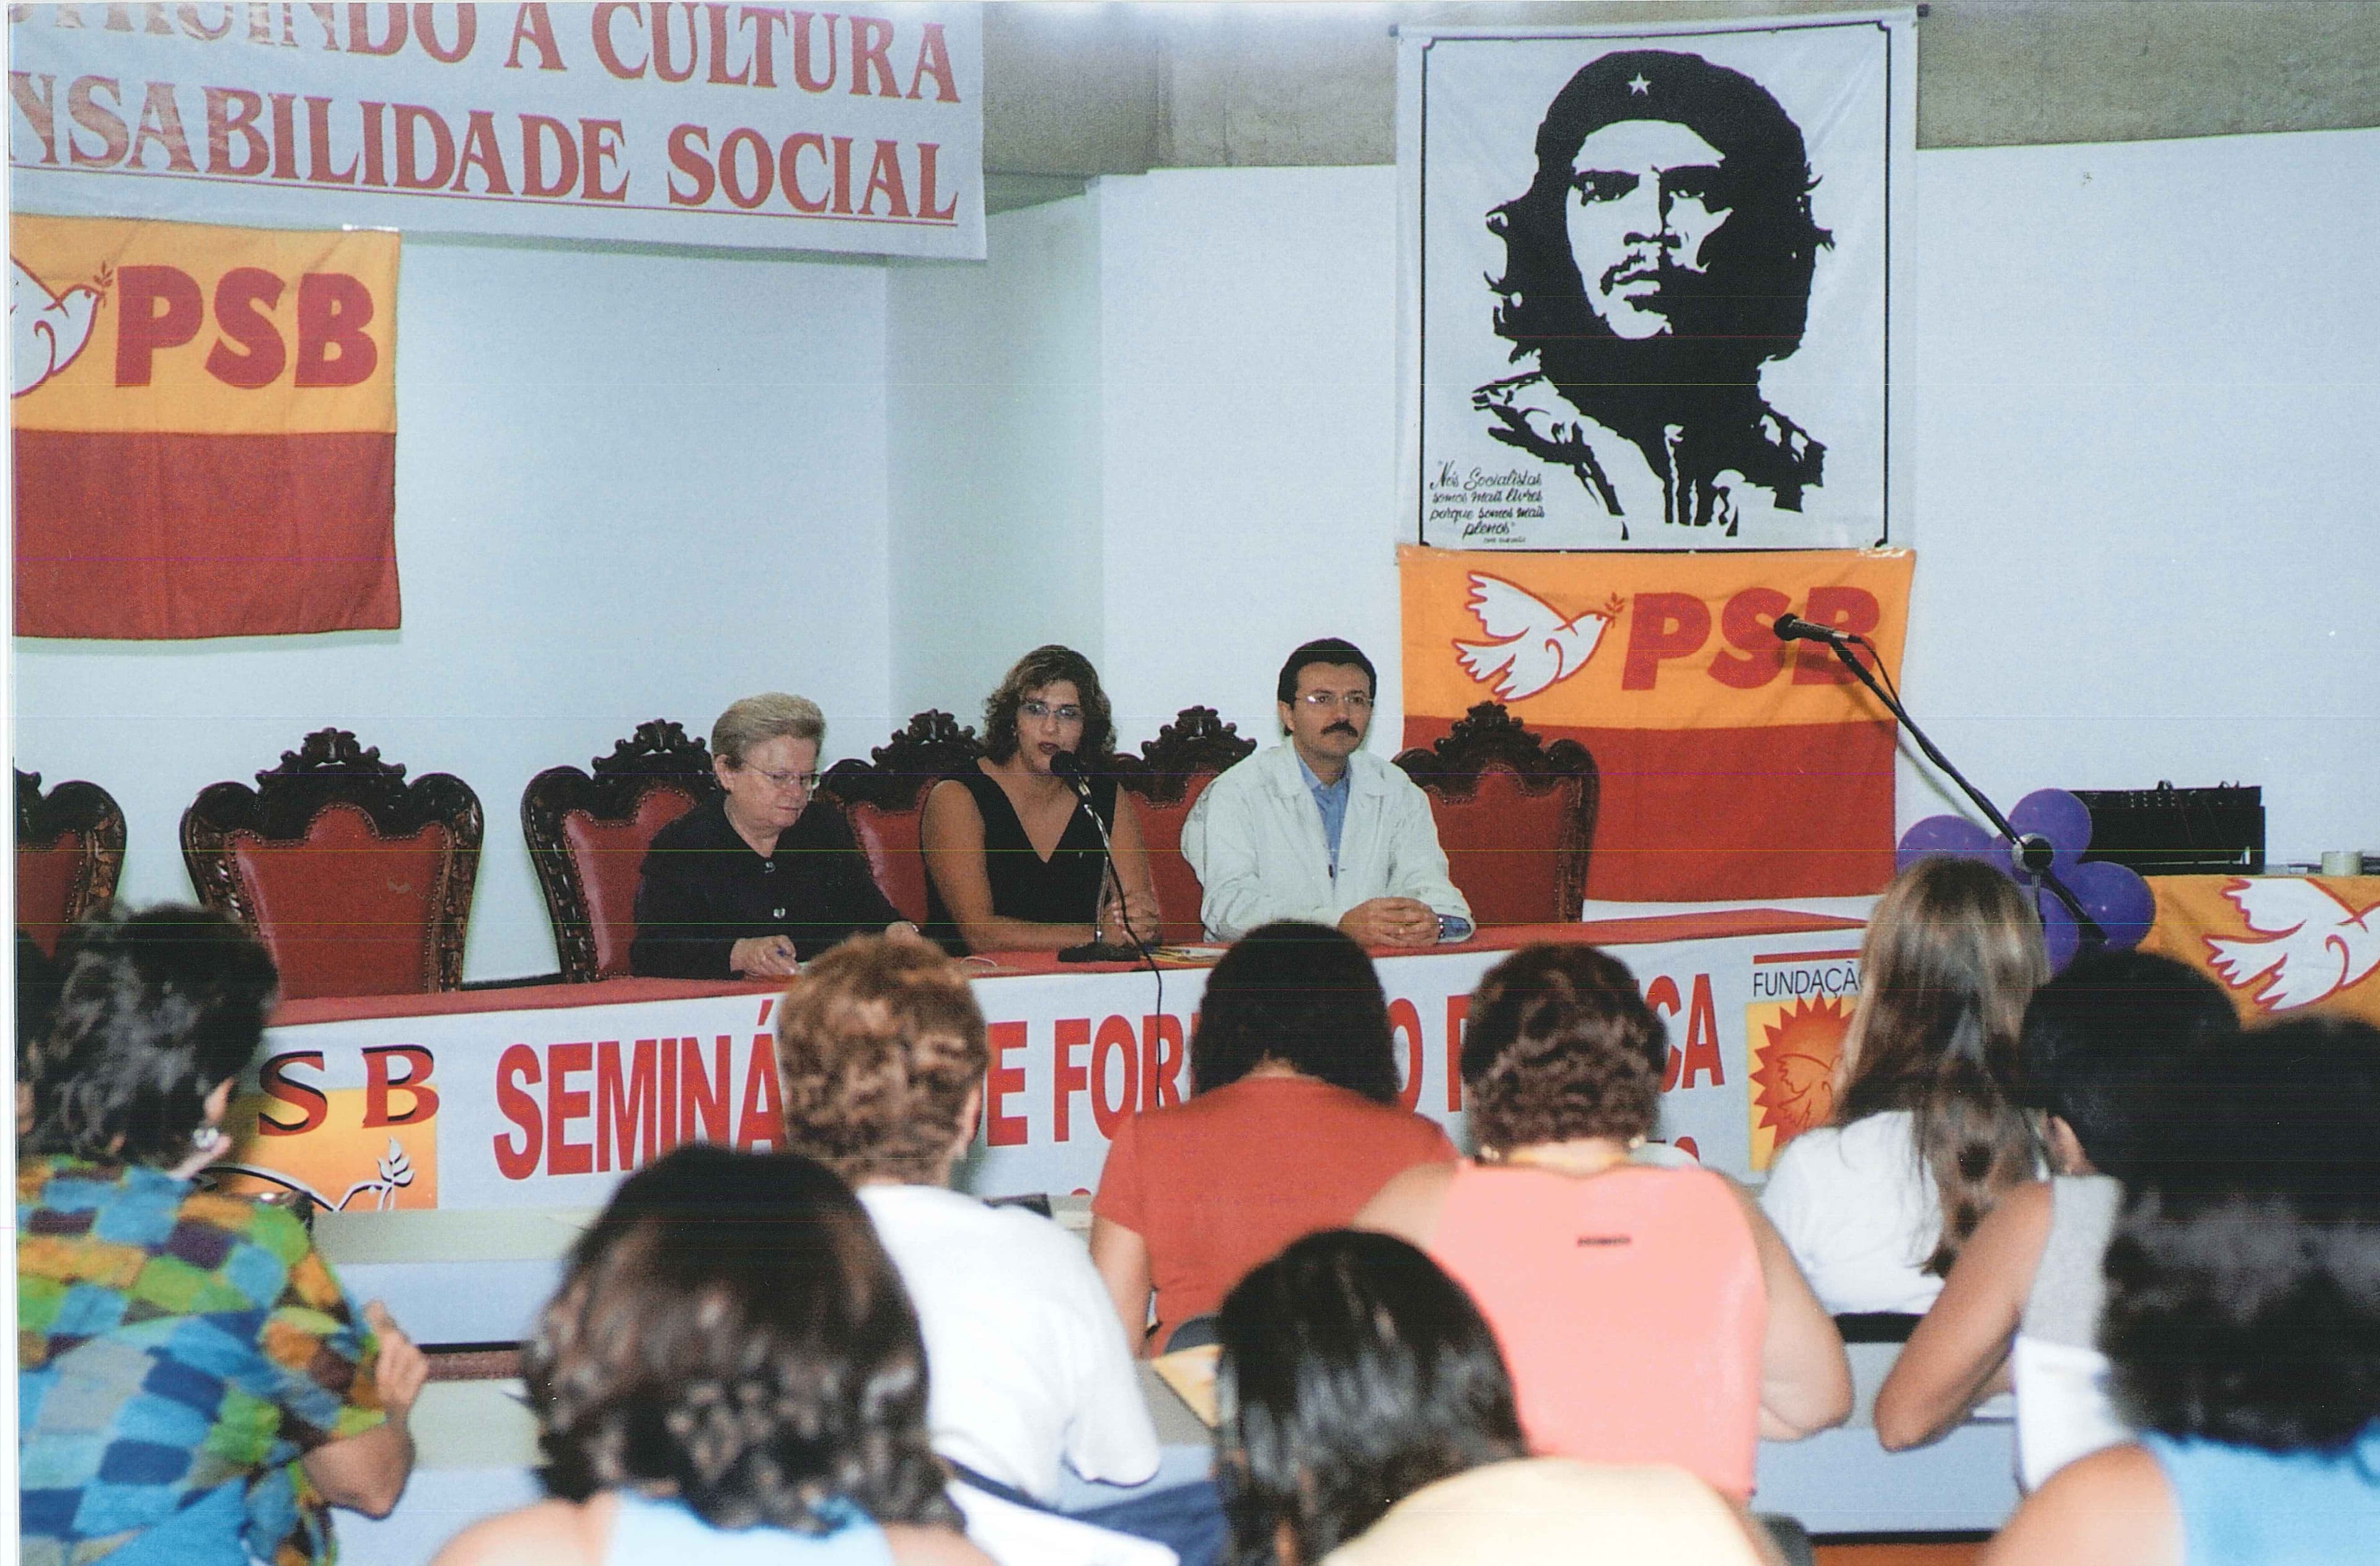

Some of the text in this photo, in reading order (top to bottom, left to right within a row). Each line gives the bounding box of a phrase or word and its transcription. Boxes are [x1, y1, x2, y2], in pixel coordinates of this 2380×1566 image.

[504, 2, 567, 70] A
[591, 2, 961, 104] CULTURA
[9, 70, 958, 220] NSABILIDADE SOCIAL
[115, 264, 378, 390] PSB
[1429, 505, 1545, 525] porque somos mais
[1432, 488, 1543, 503] somos mais livres
[1463, 467, 1543, 490] Socialistas
[1621, 586, 1880, 691] PSB
[1753, 960, 1864, 999] FUNDAÇÃ
[493, 999, 787, 1180] SEMINÁ
[1054, 1012, 1200, 1143] FOR
[1628, 973, 1726, 1093] CA
